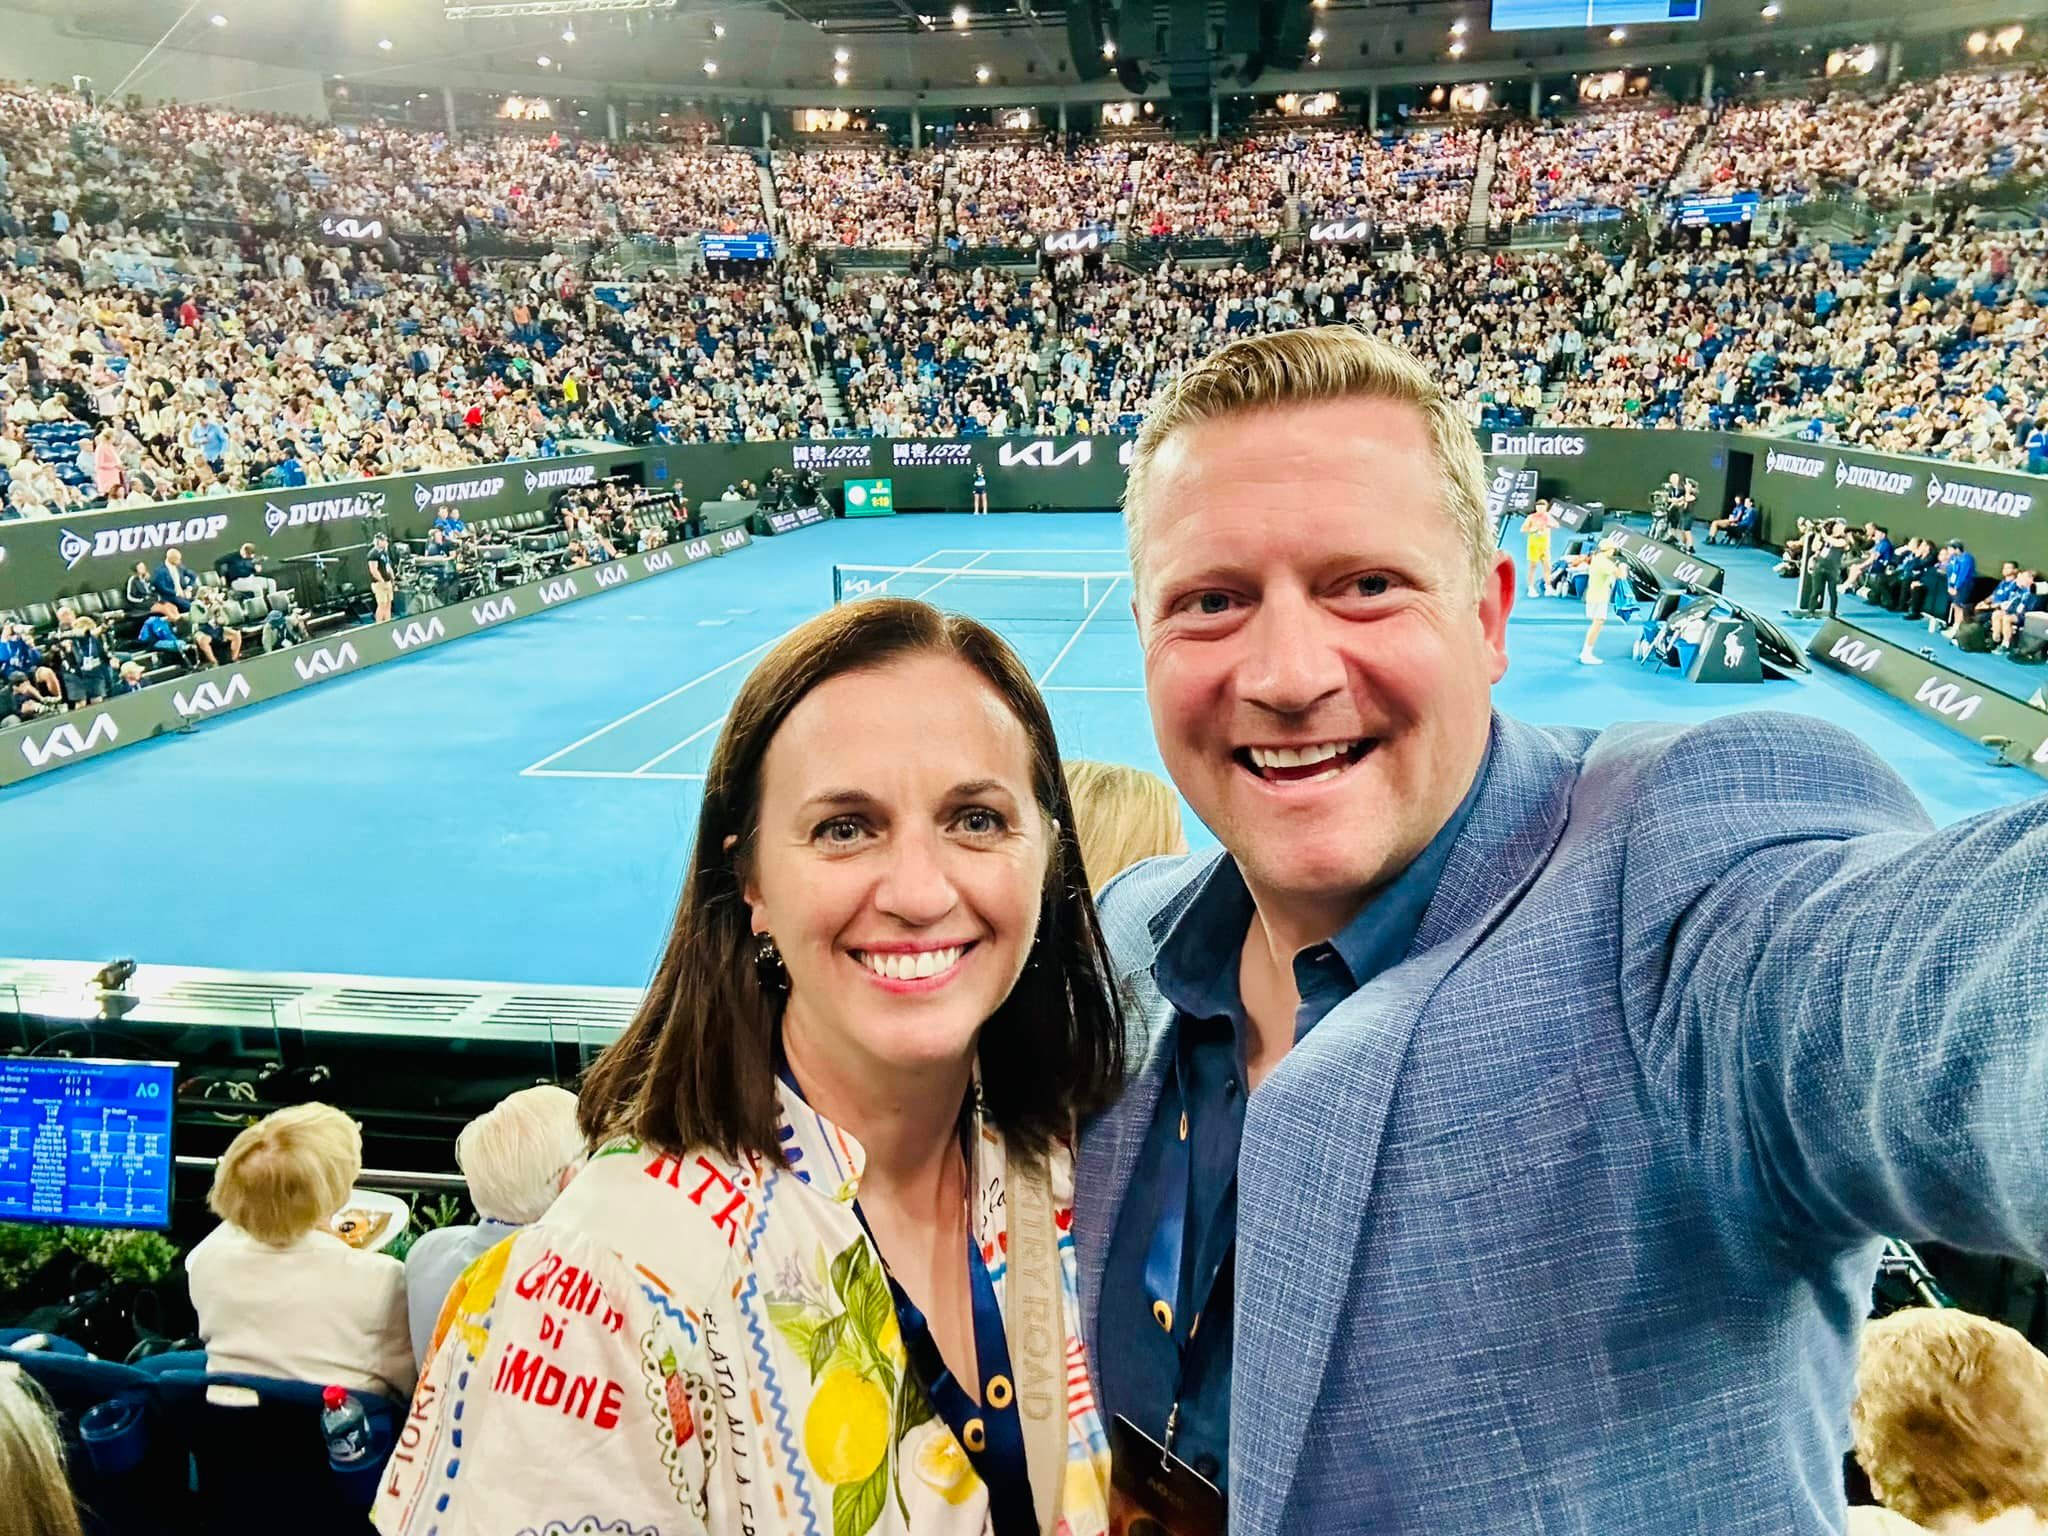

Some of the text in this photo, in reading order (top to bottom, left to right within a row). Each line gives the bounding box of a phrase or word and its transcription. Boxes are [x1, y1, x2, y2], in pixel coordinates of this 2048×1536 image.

[1045, 232, 1098, 250] KIA
[1310, 222, 1367, 241] KIA
[999, 440, 1092, 466] KIA
[1491, 432, 1584, 456] Emirates
[537, 465, 595, 489] DUNLOP
[1776, 452, 1825, 478] DUNLOP
[431, 477, 505, 505] DUNLOP
[1846, 465, 1912, 495] DUNLOP
[1941, 482, 2032, 518] DUNLOP
[92, 514, 228, 557] DUNLOP
[684, 539, 711, 559] KIA
[595, 563, 629, 587] KIA
[643, 550, 673, 572] KIA
[1673, 561, 1704, 584] KIA
[539, 578, 578, 604] KIA
[472, 595, 517, 625] KIA
[392, 616, 445, 649] KIA
[294, 641, 358, 680] KIA
[1829, 635, 1882, 672] KIA
[172, 672, 250, 716] KIA
[1914, 676, 1983, 721] KIA
[21, 712, 119, 767] KIA
[1022, 1296, 1054, 1421] ROAD
